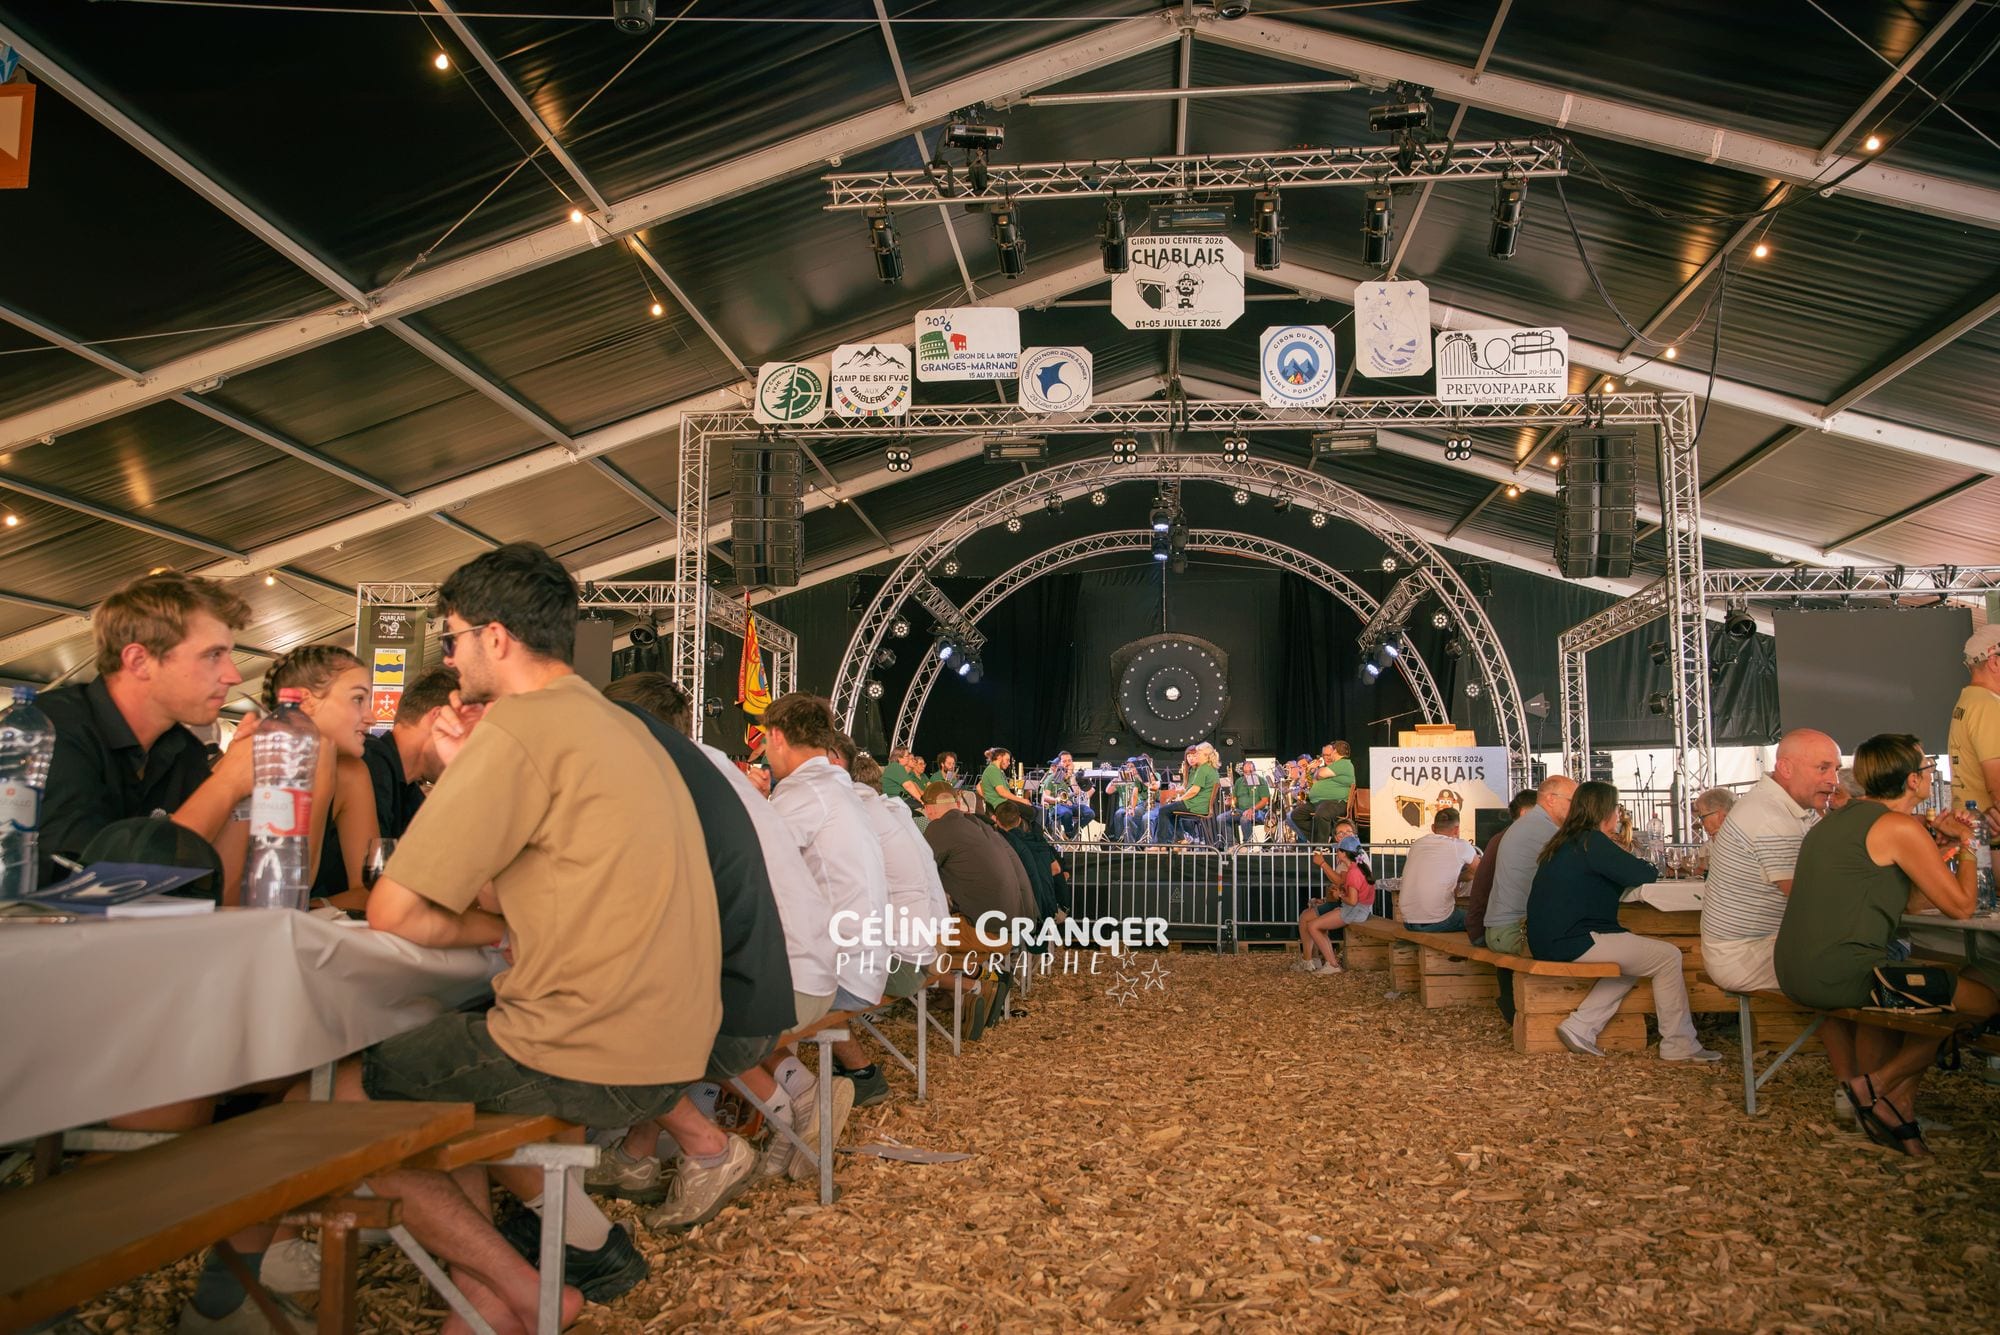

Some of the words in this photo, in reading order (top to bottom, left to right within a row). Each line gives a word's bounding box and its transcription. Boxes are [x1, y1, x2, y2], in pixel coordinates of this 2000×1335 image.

[1131, 237, 1156, 246] GIRON
[1159, 237, 1170, 245] DU
[1172, 237, 1203, 245] CENTRE
[1205, 237, 1224, 245] 2026
[1131, 248, 1224, 269] CHABLAIS
[925, 315, 952, 332] 2026
[1135, 319, 1160, 328] 01-05
[1163, 319, 1198, 328] JUILLET
[1200, 319, 1221, 327] 2026
[1273, 333, 1294, 349] GIRON
[1308, 335, 1324, 349] PIED
[953, 352, 976, 360] GIRON
[920, 361, 1018, 372] GRANGES-MARNAND
[1024, 363, 1035, 380] GIRON
[1033, 355, 1042, 364] DU
[1041, 350, 1059, 358] NORD
[1059, 350, 1075, 360] 2026
[832, 374, 857, 382] CAMP
[859, 374, 871, 382] DE
[873, 374, 887, 382] SKI
[888, 374, 910, 382] FVJC
[1268, 370, 1286, 389] MOIRY
[1292, 369, 1329, 394] POMPAPLES
[850, 384, 894, 404] DIABLERETS
[1446, 382, 1556, 395] PREVONPAPARK
[1311, 392, 1327, 405] 2026
[1464, 755, 1484, 763] 2026
[1391, 766, 1485, 787] CHABLAIS
